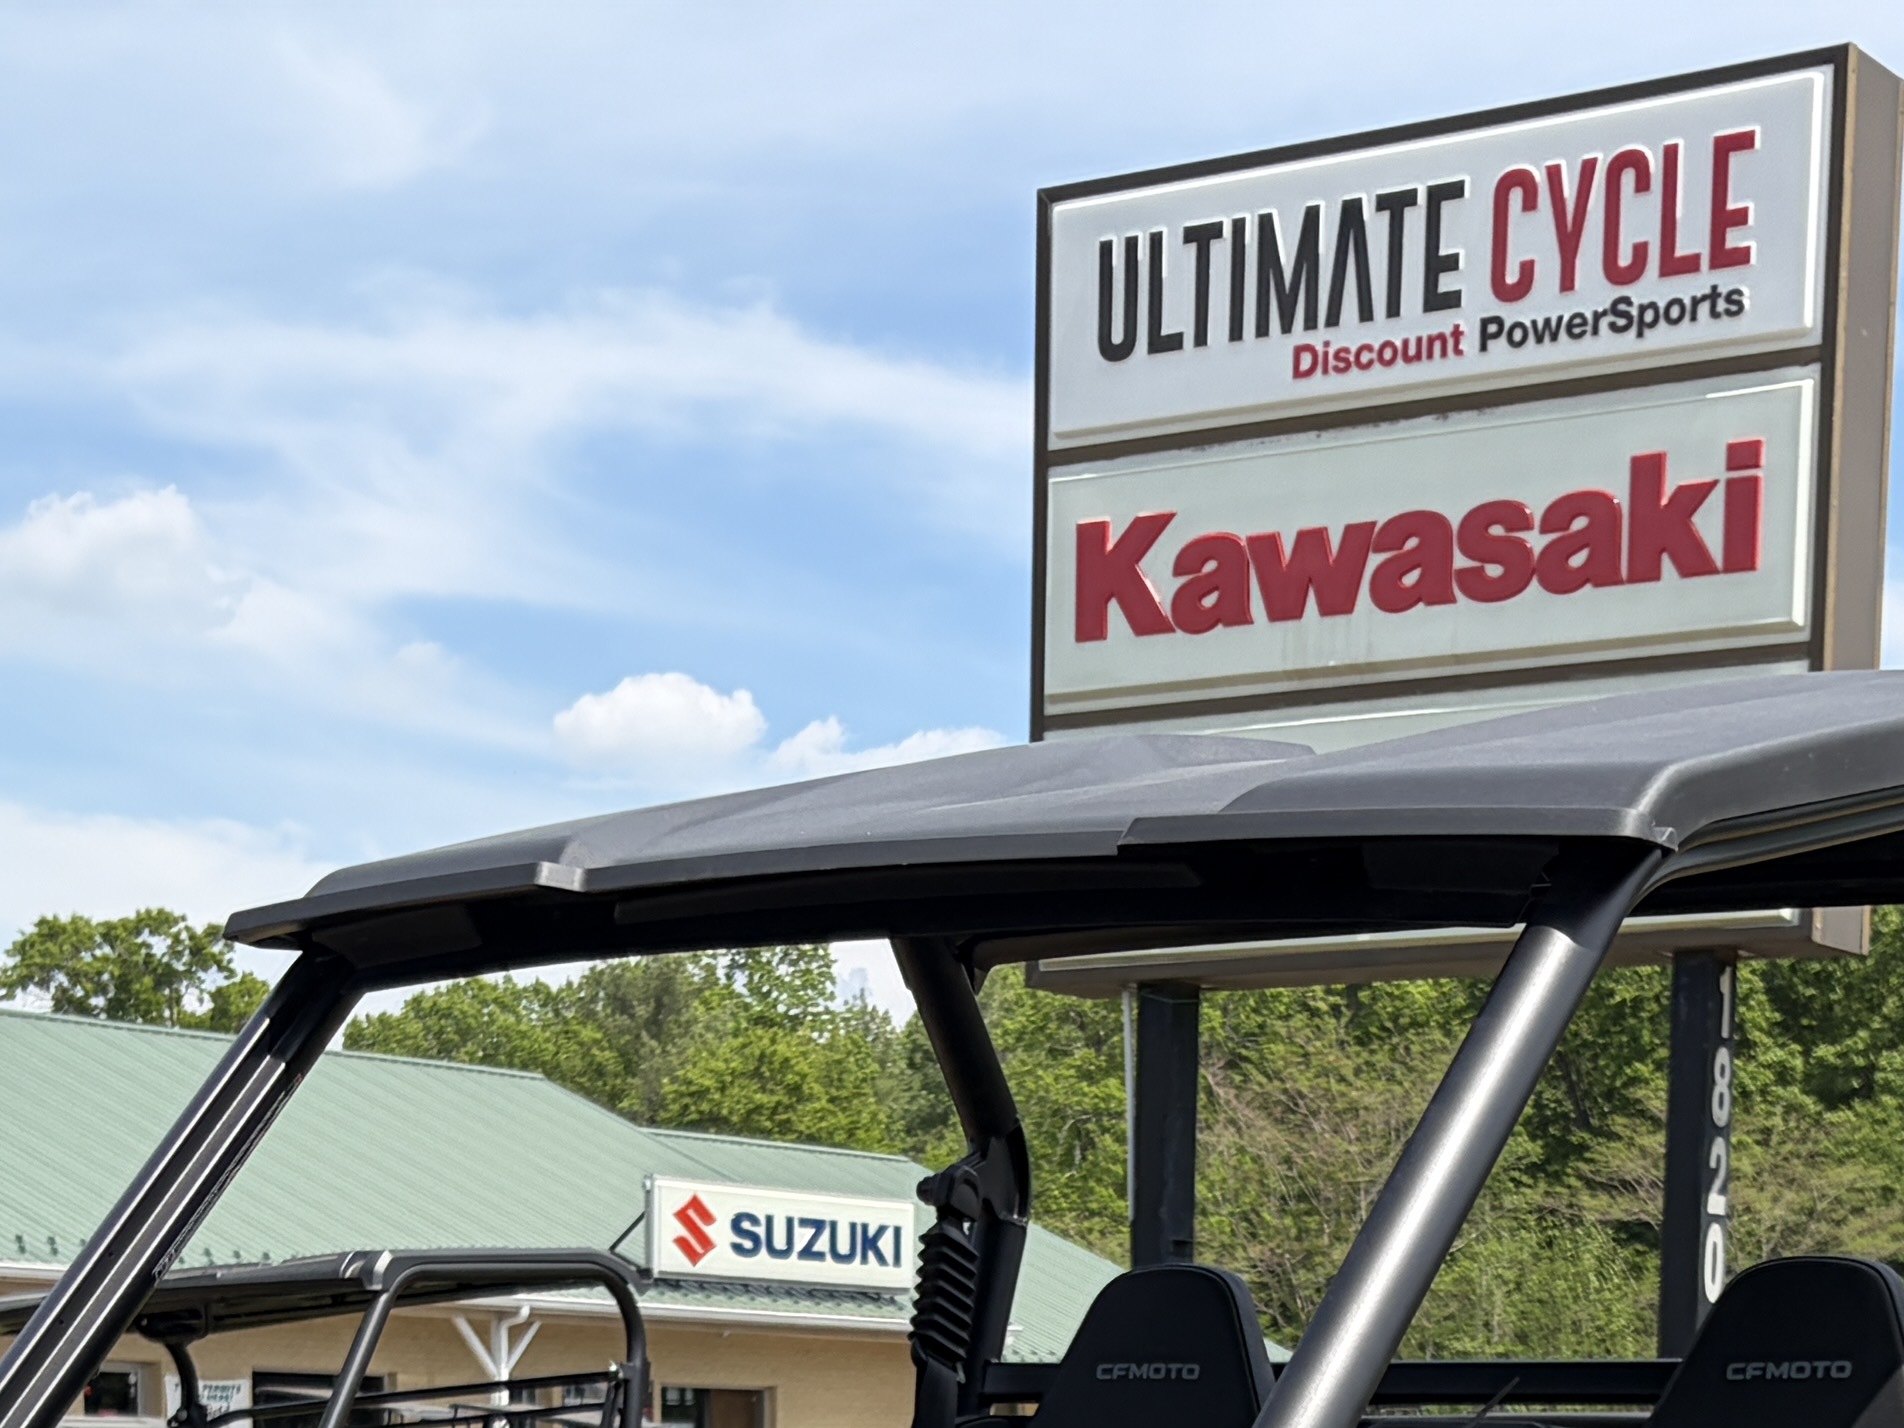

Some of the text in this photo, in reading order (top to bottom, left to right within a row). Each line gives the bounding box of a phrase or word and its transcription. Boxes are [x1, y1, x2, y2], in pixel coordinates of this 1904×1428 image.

[1097, 129, 1758, 363] ULTIMATE CYCLE
[1293, 284, 1747, 380] Discount PowerSports
[1074, 438, 1765, 644] Kawasaki
[729, 1211, 903, 1268] SUZUKI
[1096, 1363, 1200, 1381] CFMOTO
[1726, 1361, 1852, 1381] CFMOTO
